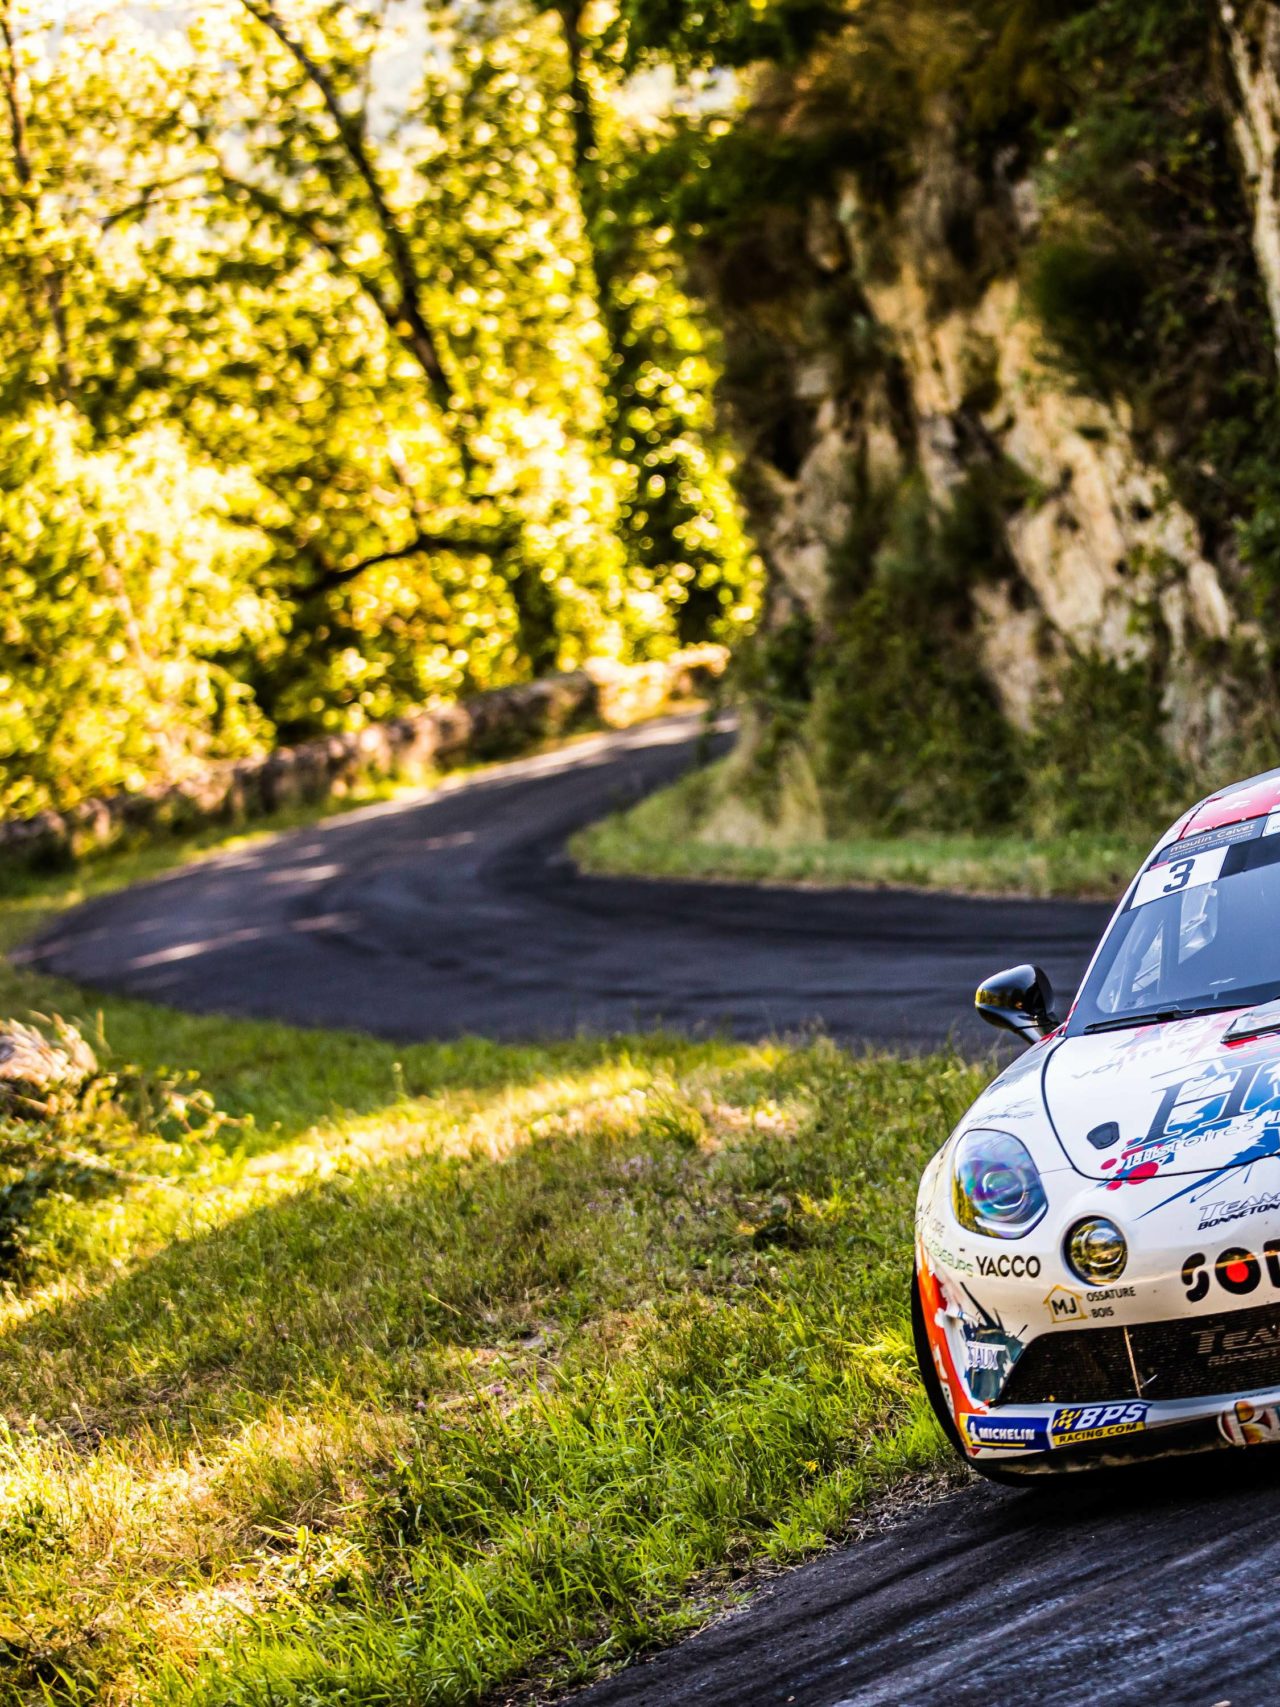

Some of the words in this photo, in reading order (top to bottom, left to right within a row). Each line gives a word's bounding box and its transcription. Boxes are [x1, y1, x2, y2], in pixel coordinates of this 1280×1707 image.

[1163, 858, 1196, 893] 3
[1197, 1202, 1280, 1231] BONNETON
[975, 1254, 1041, 1279] YACCO
[1052, 1297, 1078, 1315] MJ
[1086, 1286, 1136, 1302] OSSATURE
[1091, 1307, 1115, 1319] BOIS
[1074, 1404, 1145, 1430] BPS
[979, 1427, 1035, 1441] MICHELIN
[1059, 1424, 1137, 1444] RACING.COM
